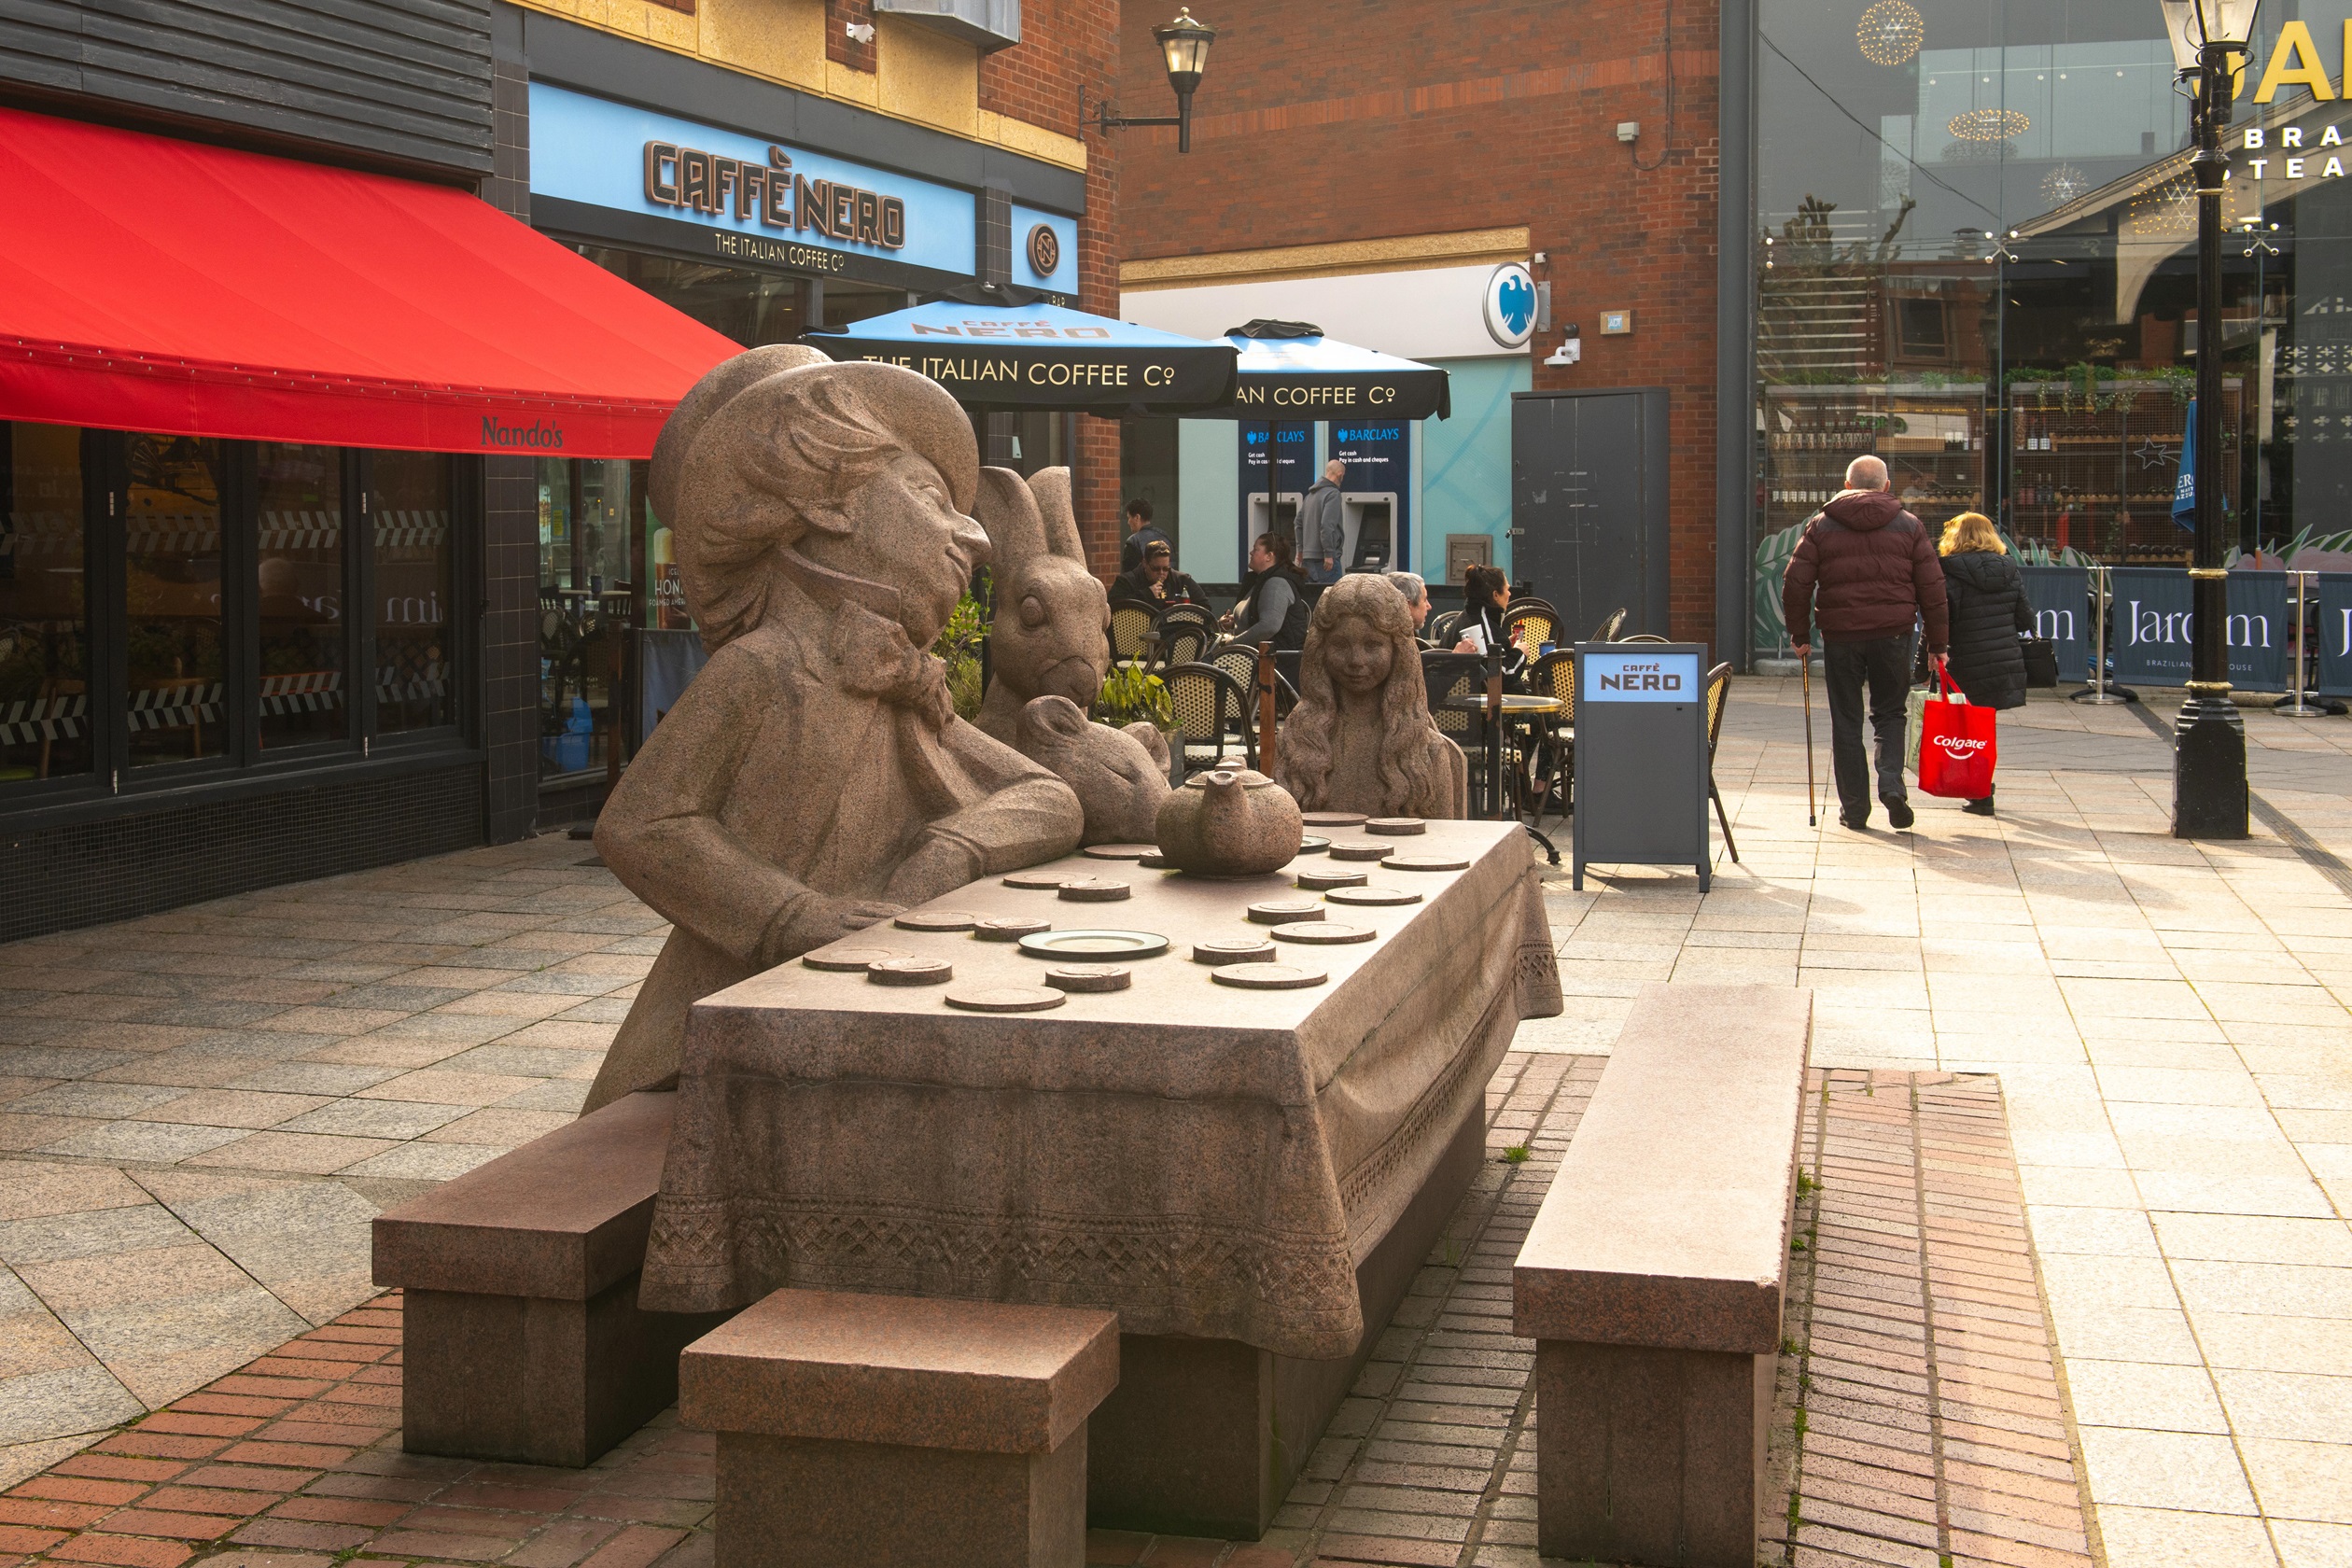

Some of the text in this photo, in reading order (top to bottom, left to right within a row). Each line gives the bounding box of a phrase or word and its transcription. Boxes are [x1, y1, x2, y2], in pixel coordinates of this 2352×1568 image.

[2222, 156, 2345, 181] TEA
[795, 173, 905, 249] NERO
[715, 233, 737, 256] THE
[740, 238, 785, 262] ITALIAN
[790, 245, 828, 271] COFFEE
[911, 323, 1111, 339] NERO
[922, 357, 1018, 382] ITALIAN
[1028, 363, 1128, 386] COFFEE
[1273, 386, 1356, 405] COFFEE
[481, 416, 563, 448] Nando's
[1257, 430, 1305, 443] BACLAYS
[1349, 427, 1399, 441] BARCLAYS
[2147, 659, 2191, 668] BRAZILIAN
[1600, 673, 1682, 691] NERO
